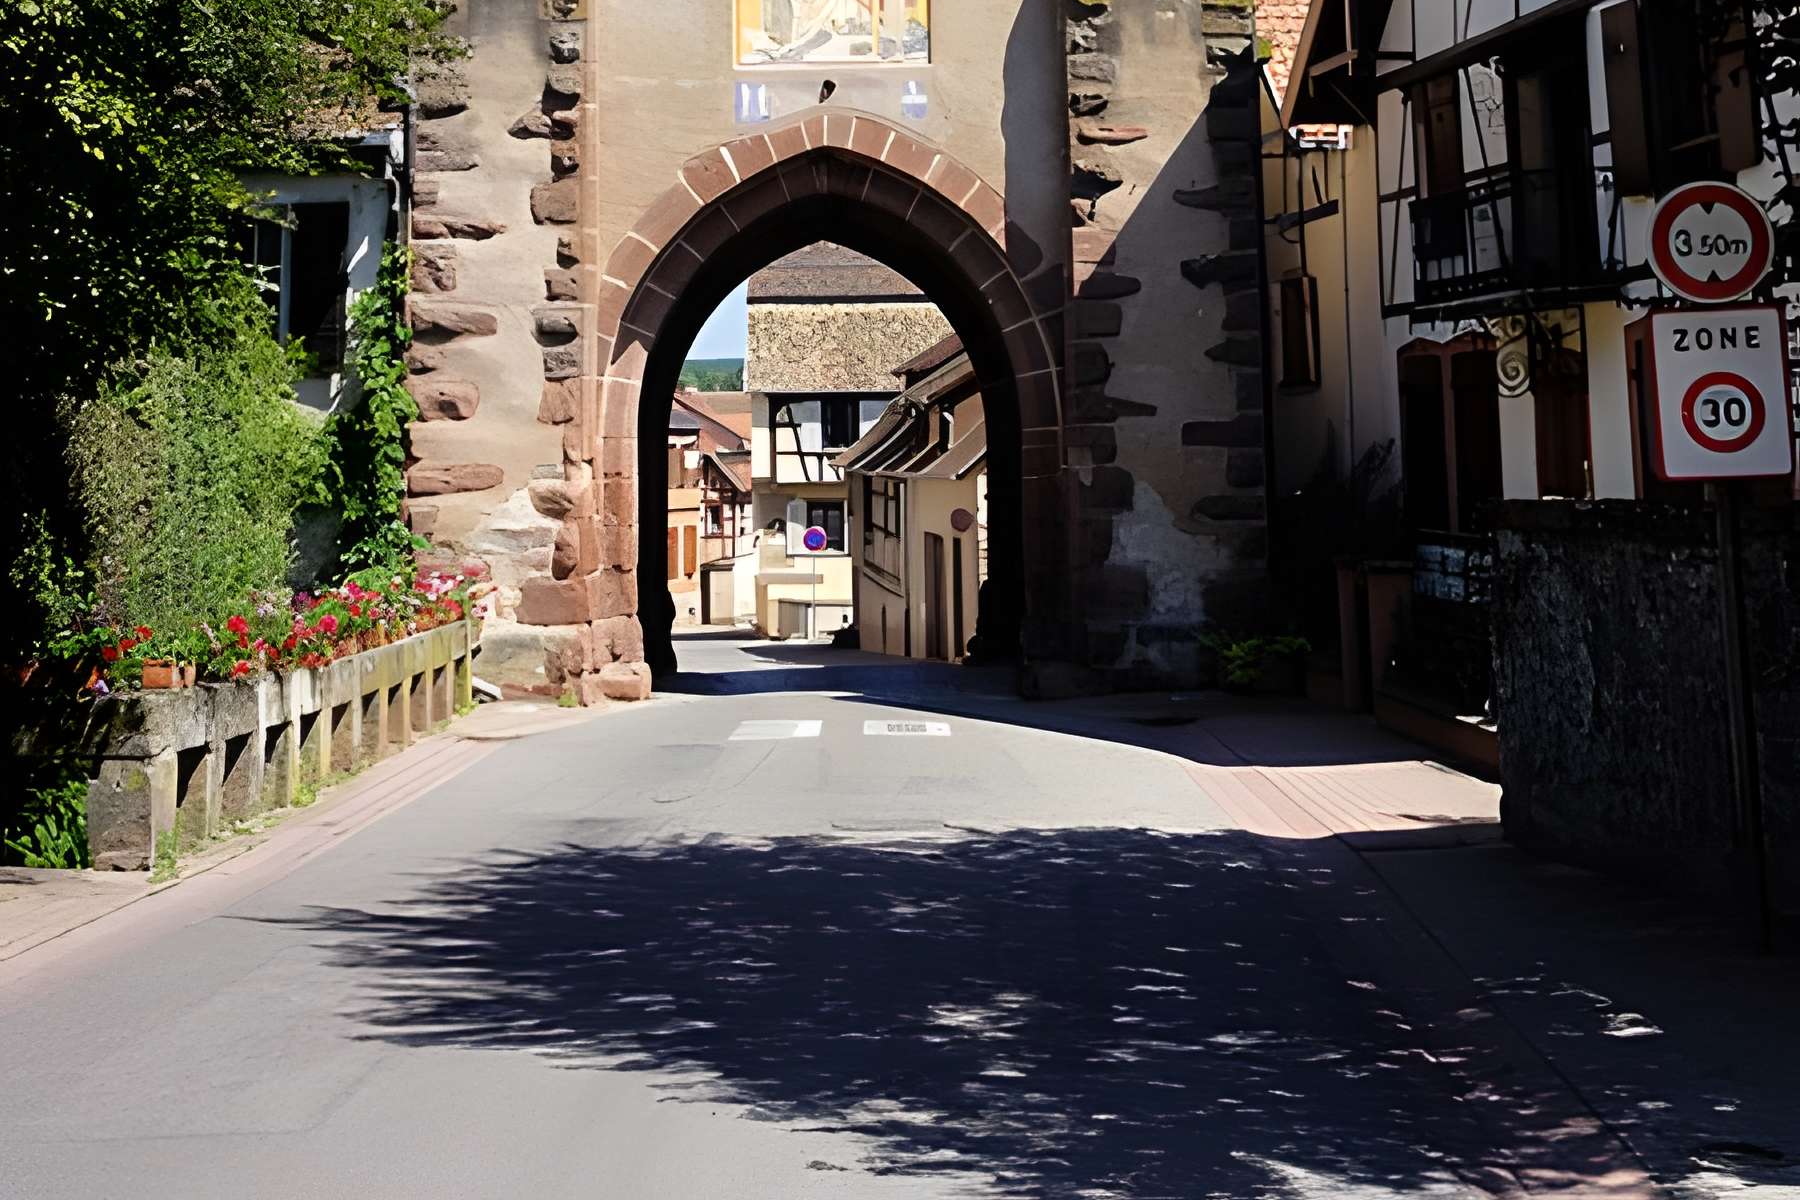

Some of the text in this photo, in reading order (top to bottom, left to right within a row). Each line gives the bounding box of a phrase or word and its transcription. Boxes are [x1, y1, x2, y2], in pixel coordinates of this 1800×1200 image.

[1674, 229, 1748, 257] 350m
[1673, 326, 1760, 352] ZONE
[1701, 397, 1746, 428] 30
